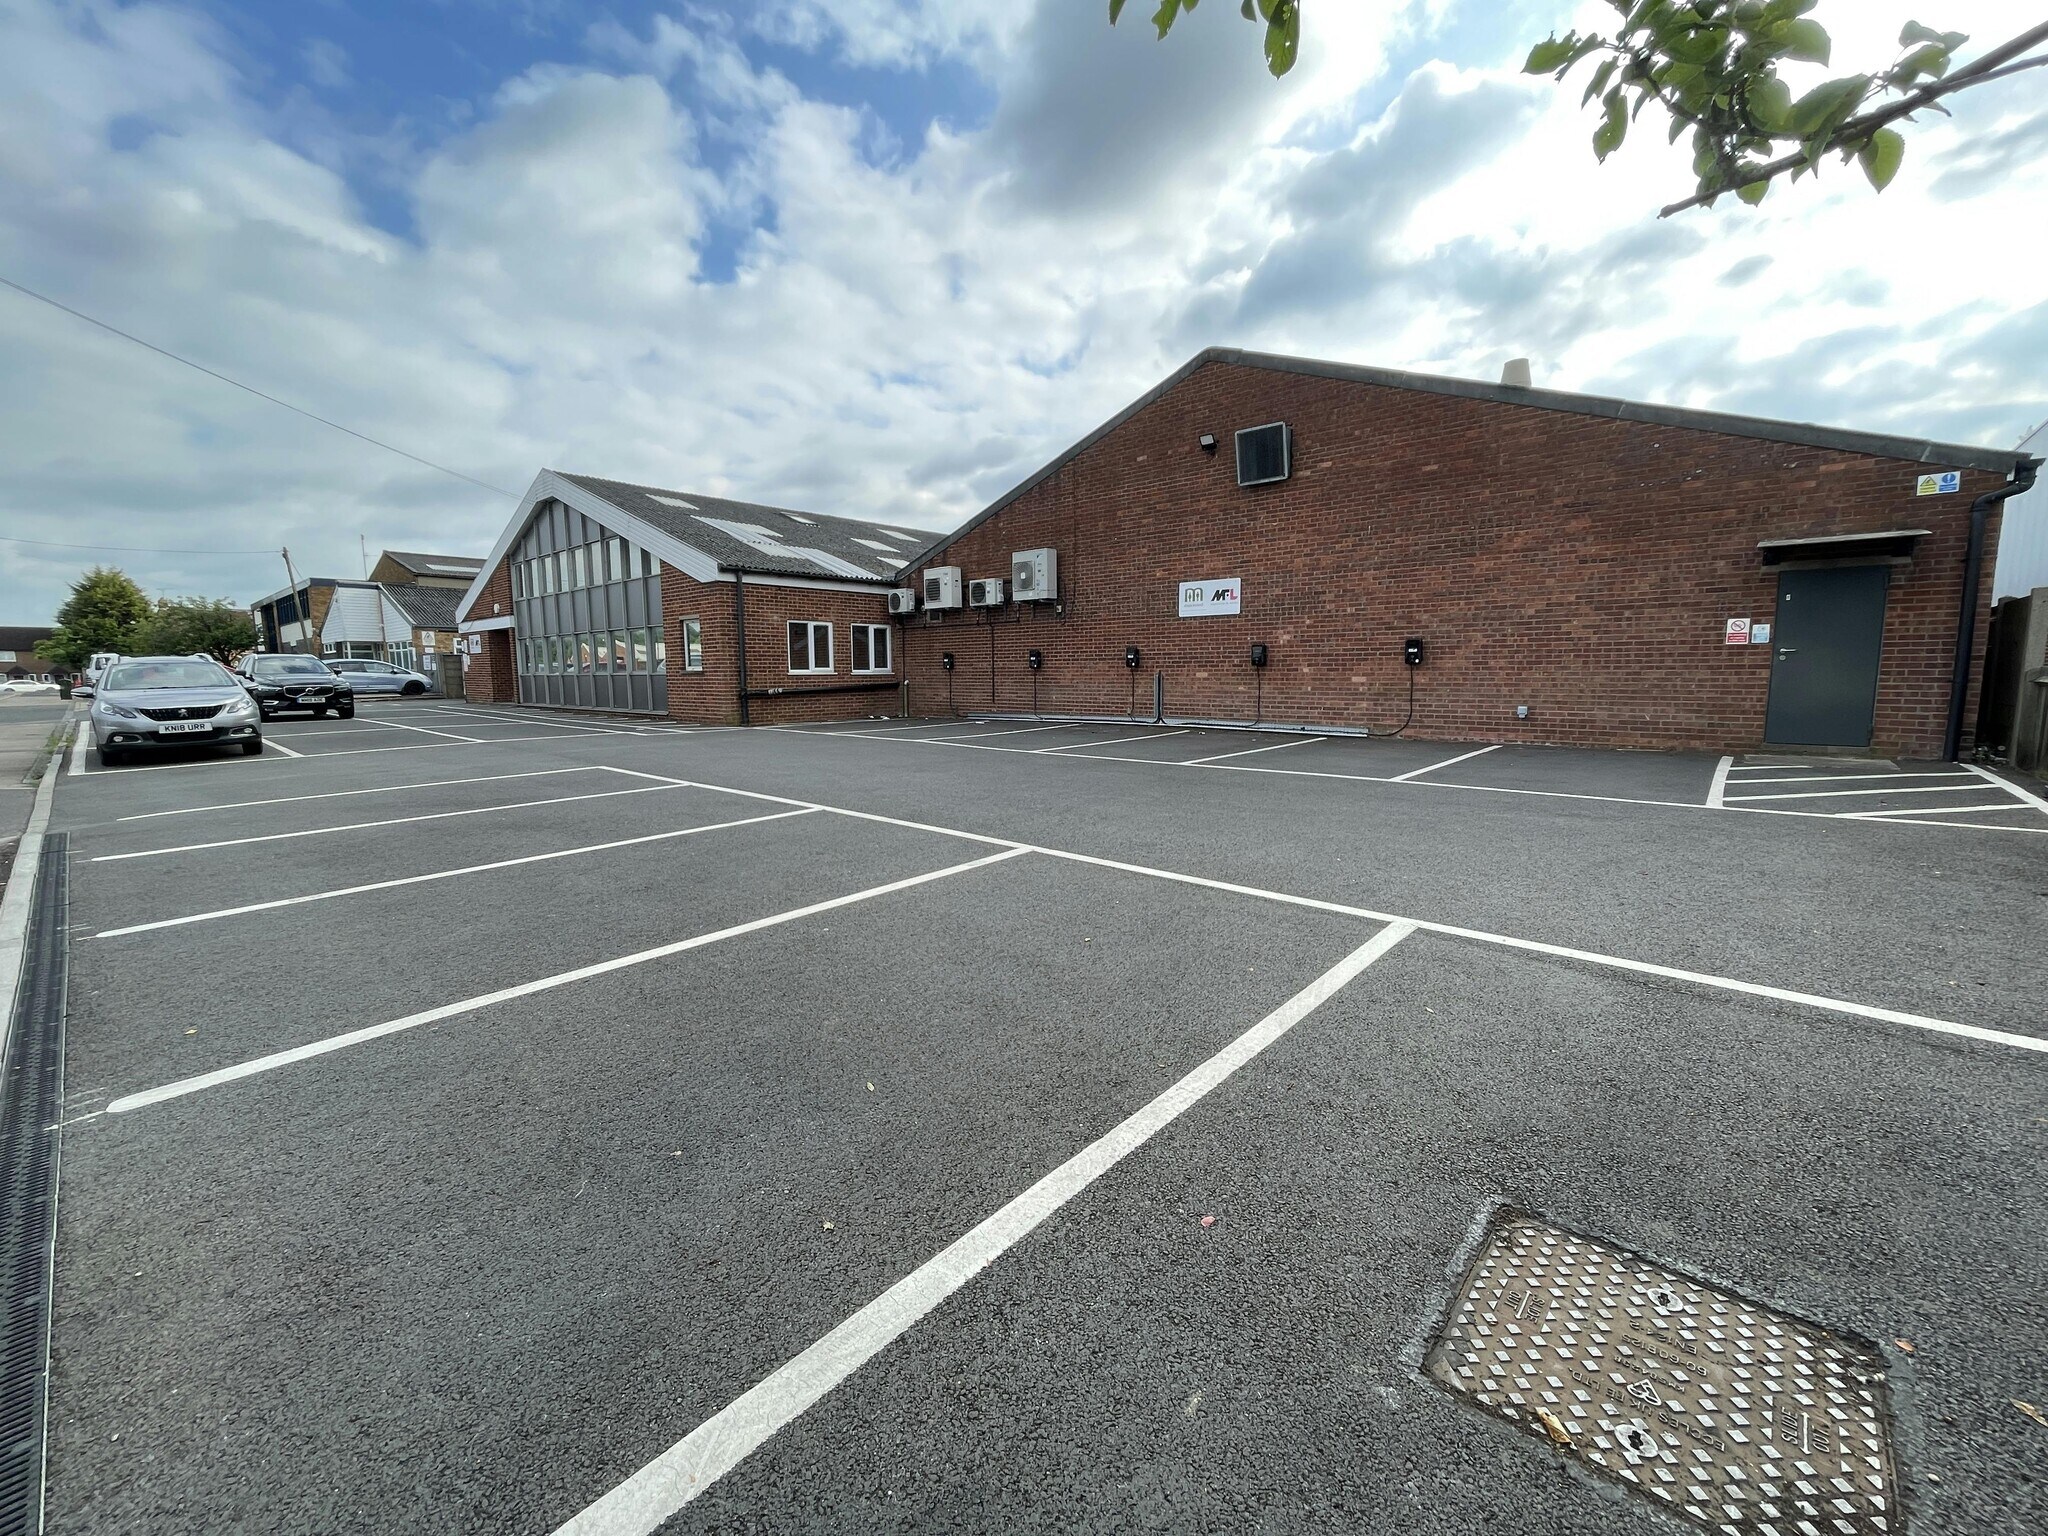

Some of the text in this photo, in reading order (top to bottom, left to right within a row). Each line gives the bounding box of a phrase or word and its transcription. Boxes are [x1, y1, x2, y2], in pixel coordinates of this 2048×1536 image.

[187, 723, 205, 731] URR
[1504, 1290, 1522, 1310] OUT
[1525, 1296, 1545, 1323] SLIDE
[1630, 1399, 1653, 1417] UK
[1658, 1411, 1725, 1453] ECCLES
[1781, 1406, 1798, 1445] SLIDE
[1812, 1425, 1829, 1453] OUT
